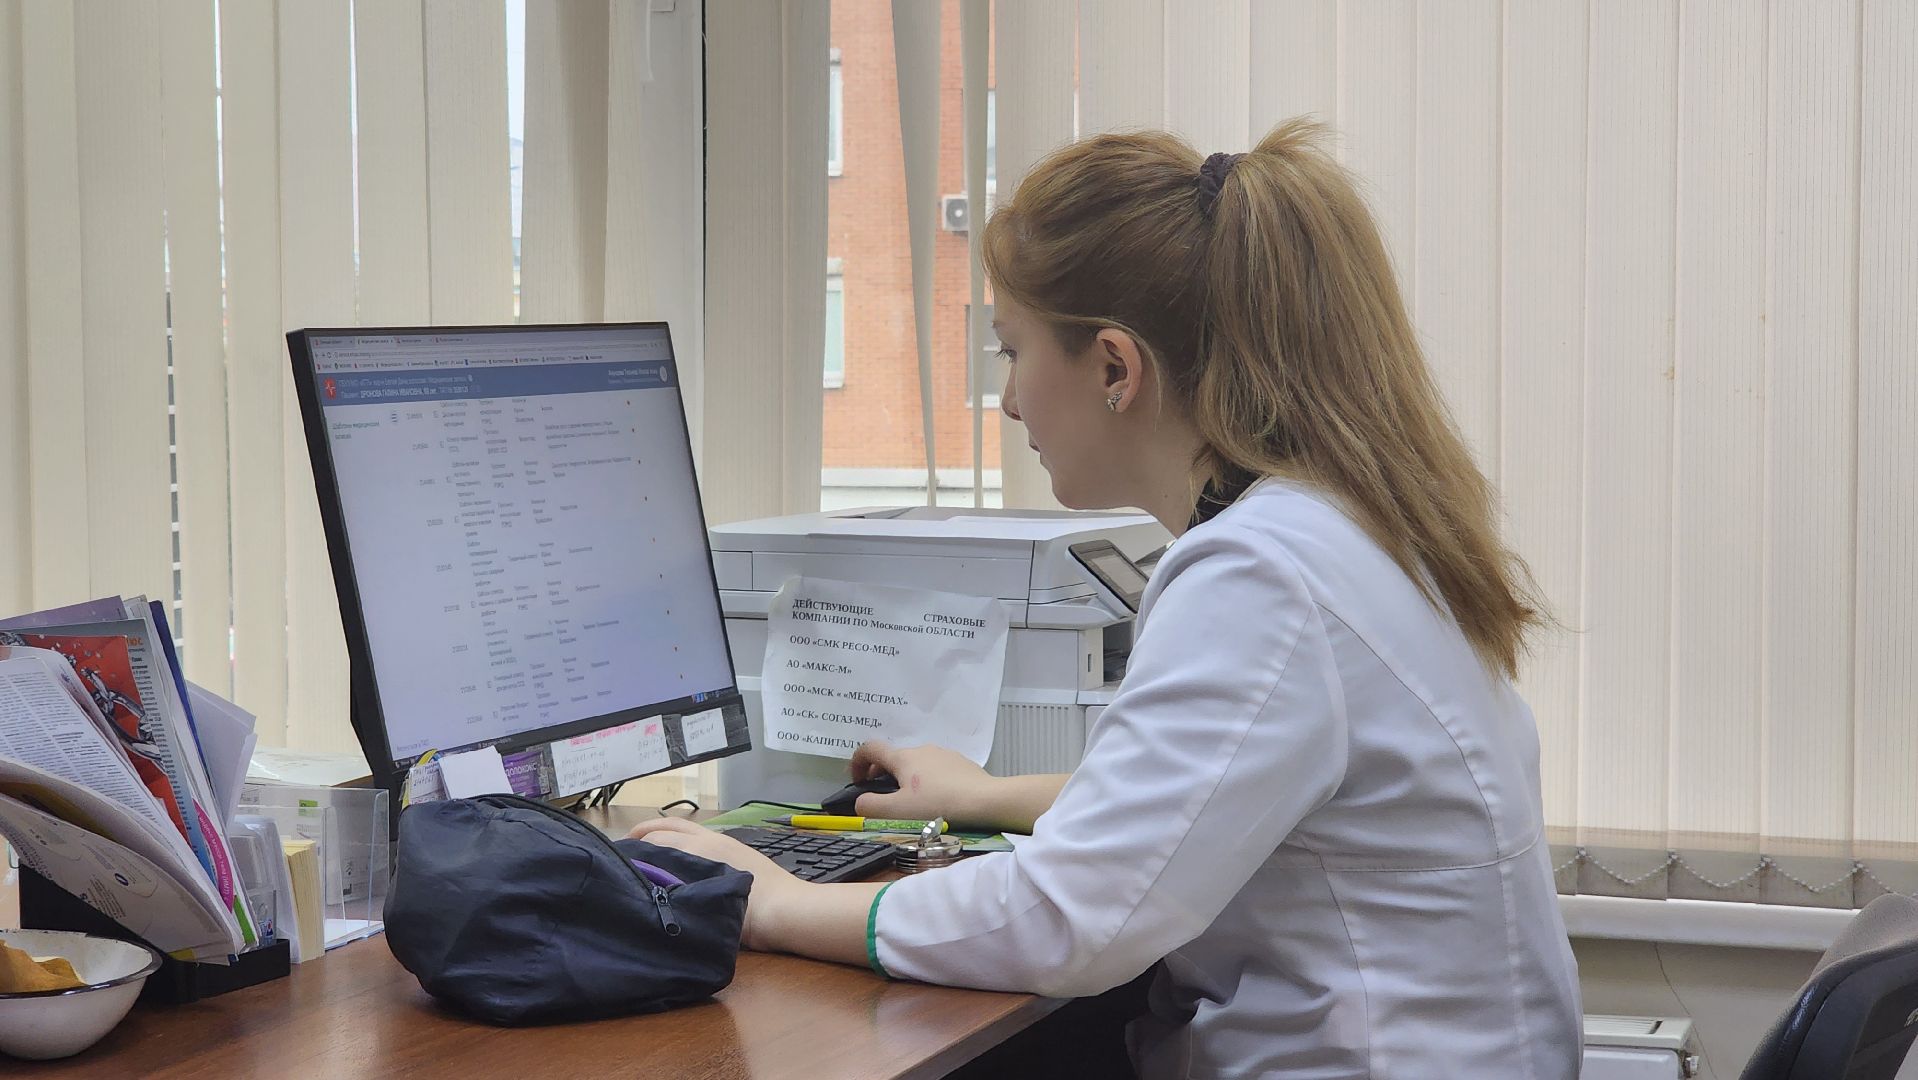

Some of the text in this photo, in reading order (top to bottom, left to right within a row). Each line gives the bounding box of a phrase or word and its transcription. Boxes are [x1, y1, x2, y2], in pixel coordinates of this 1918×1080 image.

[792, 599, 986, 628] ДЕЙСТВУЮЩИЕ СТРАХОВЫЕ
[792, 610, 975, 640] КОМПАНИИ ПО Московской ОБЛАСТИ
[789, 635, 900, 656] ООО «СМК РЕСО-МЕД»
[786, 658, 852, 675] АО «МАКС-М»
[783, 683, 805, 694] ООО
[806, 685, 834, 697] «МСК
[843, 691, 909, 706] «МЕДСТРАХ»
[781, 707, 882, 728] АО «СК» СОГАЗ-МЕД»
[777, 730, 800, 742] ООО
[802, 734, 854, 748] «КАПИТАЛ
